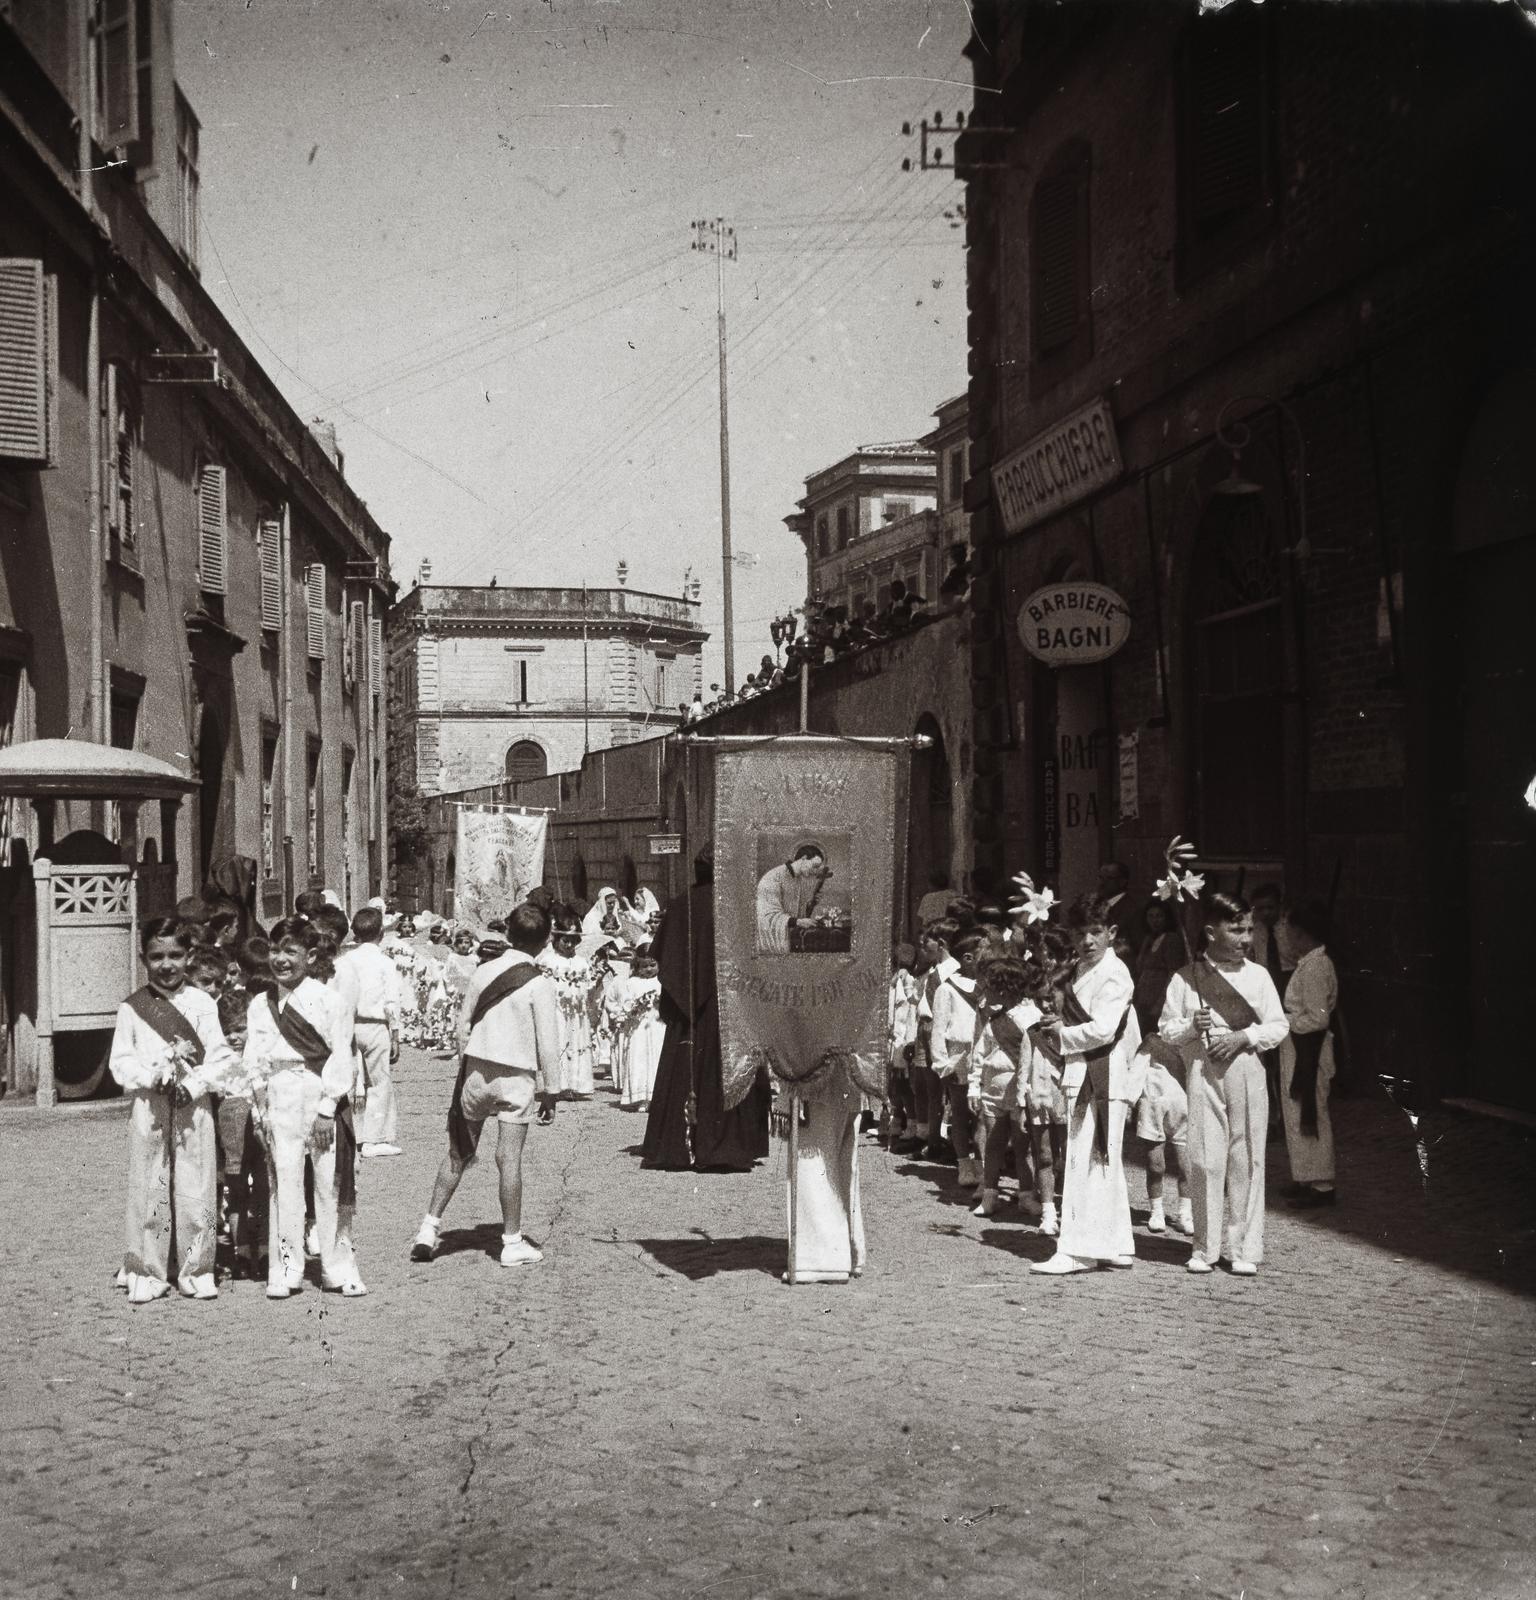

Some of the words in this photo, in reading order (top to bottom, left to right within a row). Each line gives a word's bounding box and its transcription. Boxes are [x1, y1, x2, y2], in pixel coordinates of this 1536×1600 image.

[996, 414, 1111, 522] PARRUCCHIERE
[1028, 592, 1117, 623] BARBIERE
[1037, 627, 1111, 649] BAGNI
[1066, 792, 1099, 827] BA
